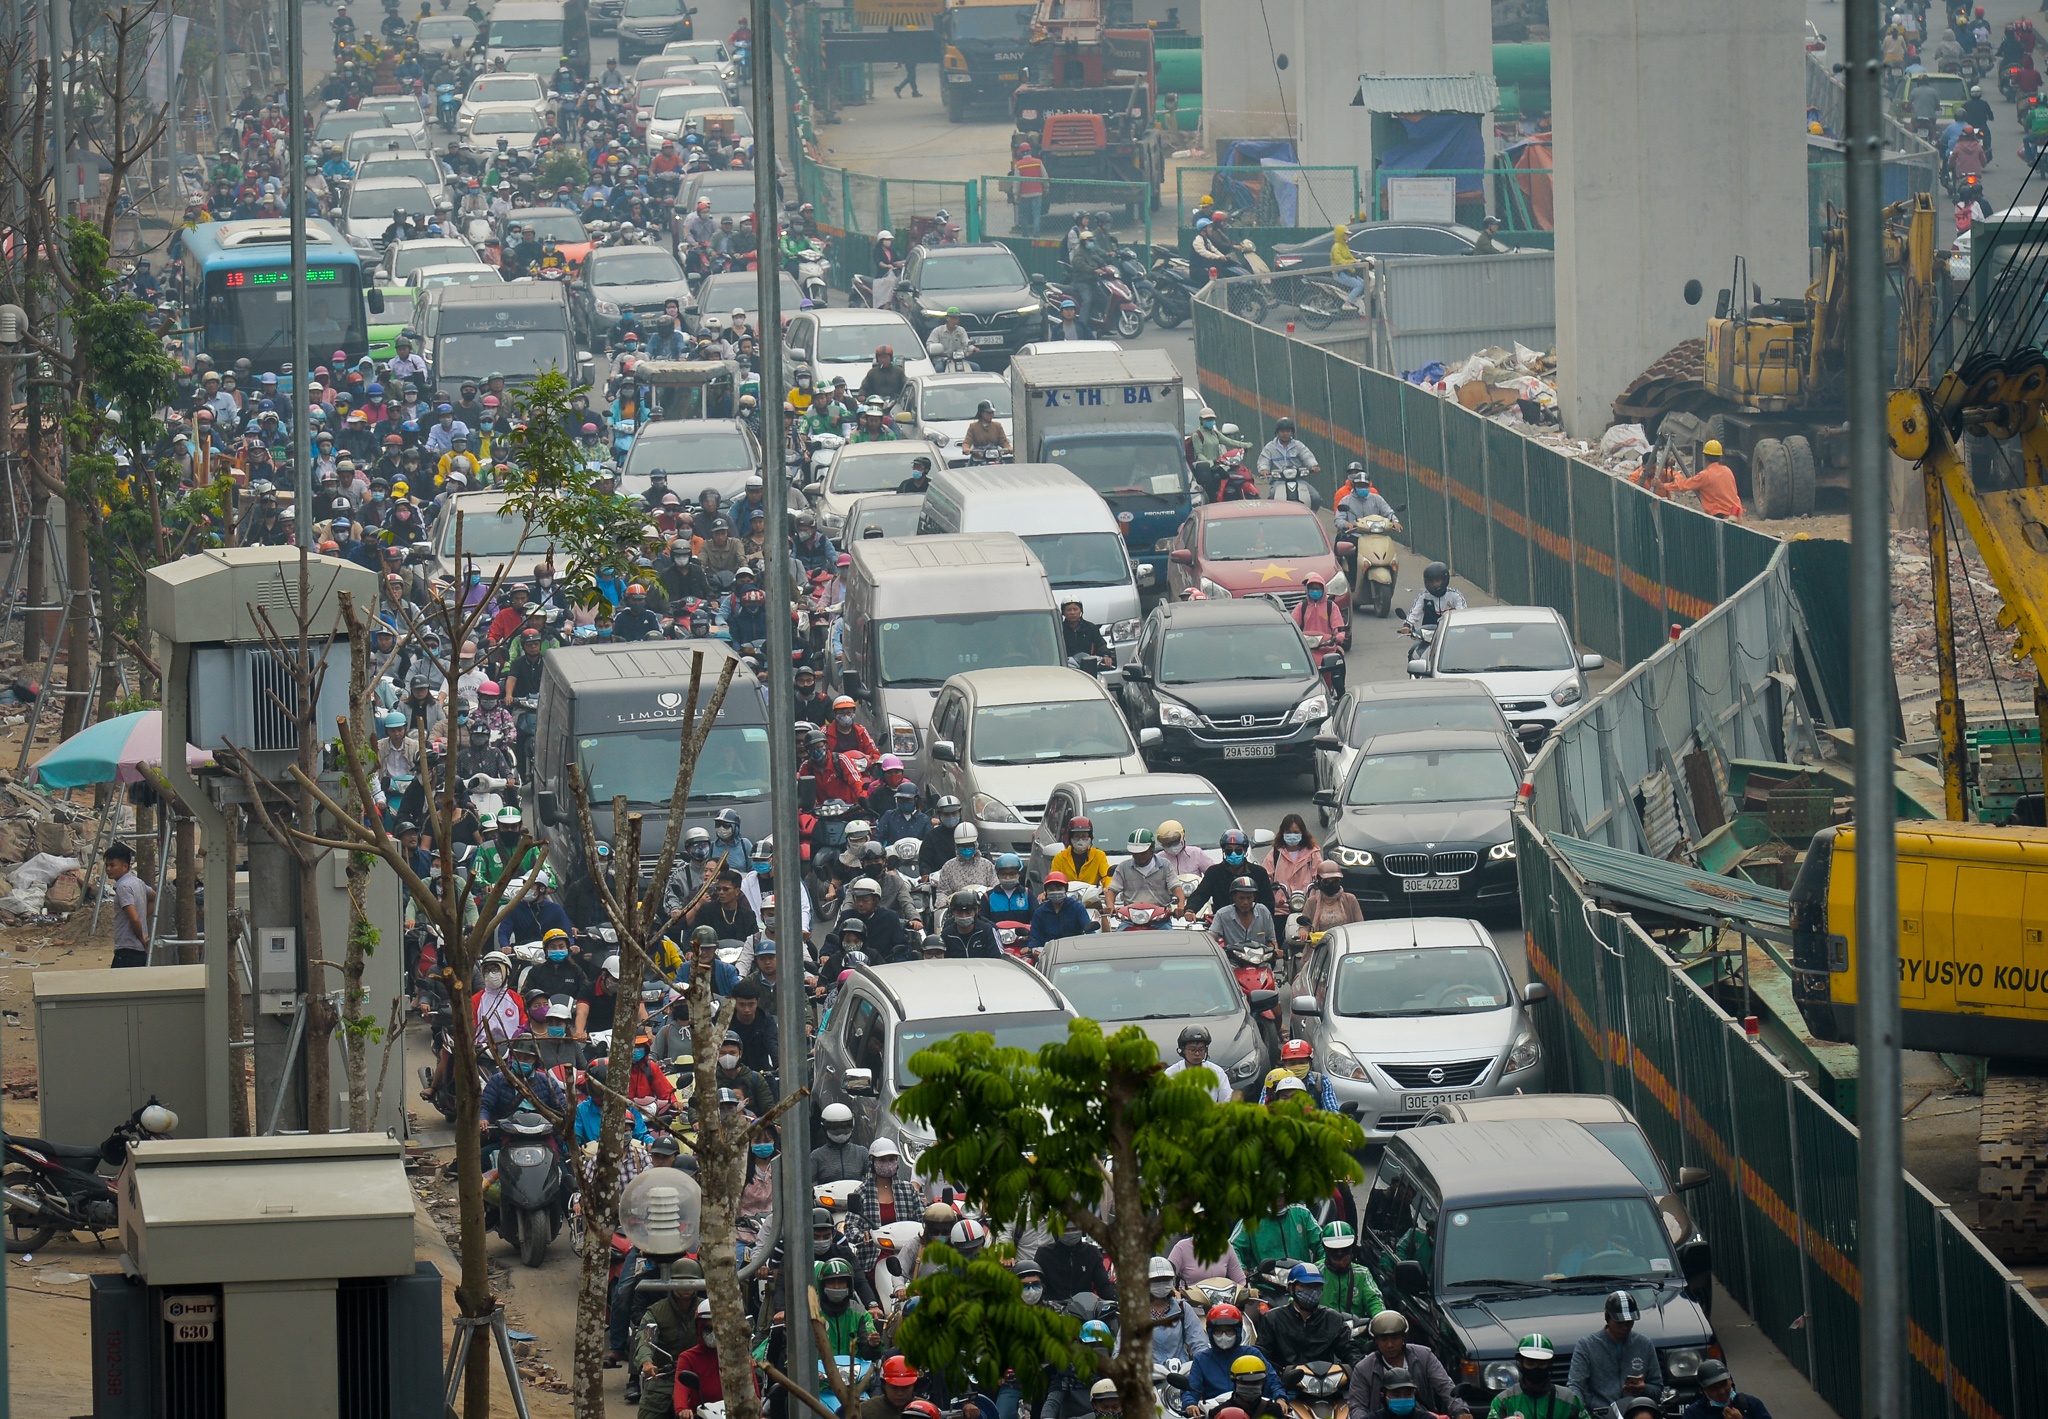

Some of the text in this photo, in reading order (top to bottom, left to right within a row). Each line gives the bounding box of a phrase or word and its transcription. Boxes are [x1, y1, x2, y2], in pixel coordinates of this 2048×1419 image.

[994, 52, 1025, 61] SANY
[1225, 746, 1274, 757] 29A-596.03
[1405, 878, 1458, 891] 30E-422.23
[185, 1304, 216, 1313] HBT
[179, 1325, 209, 1339] 630
